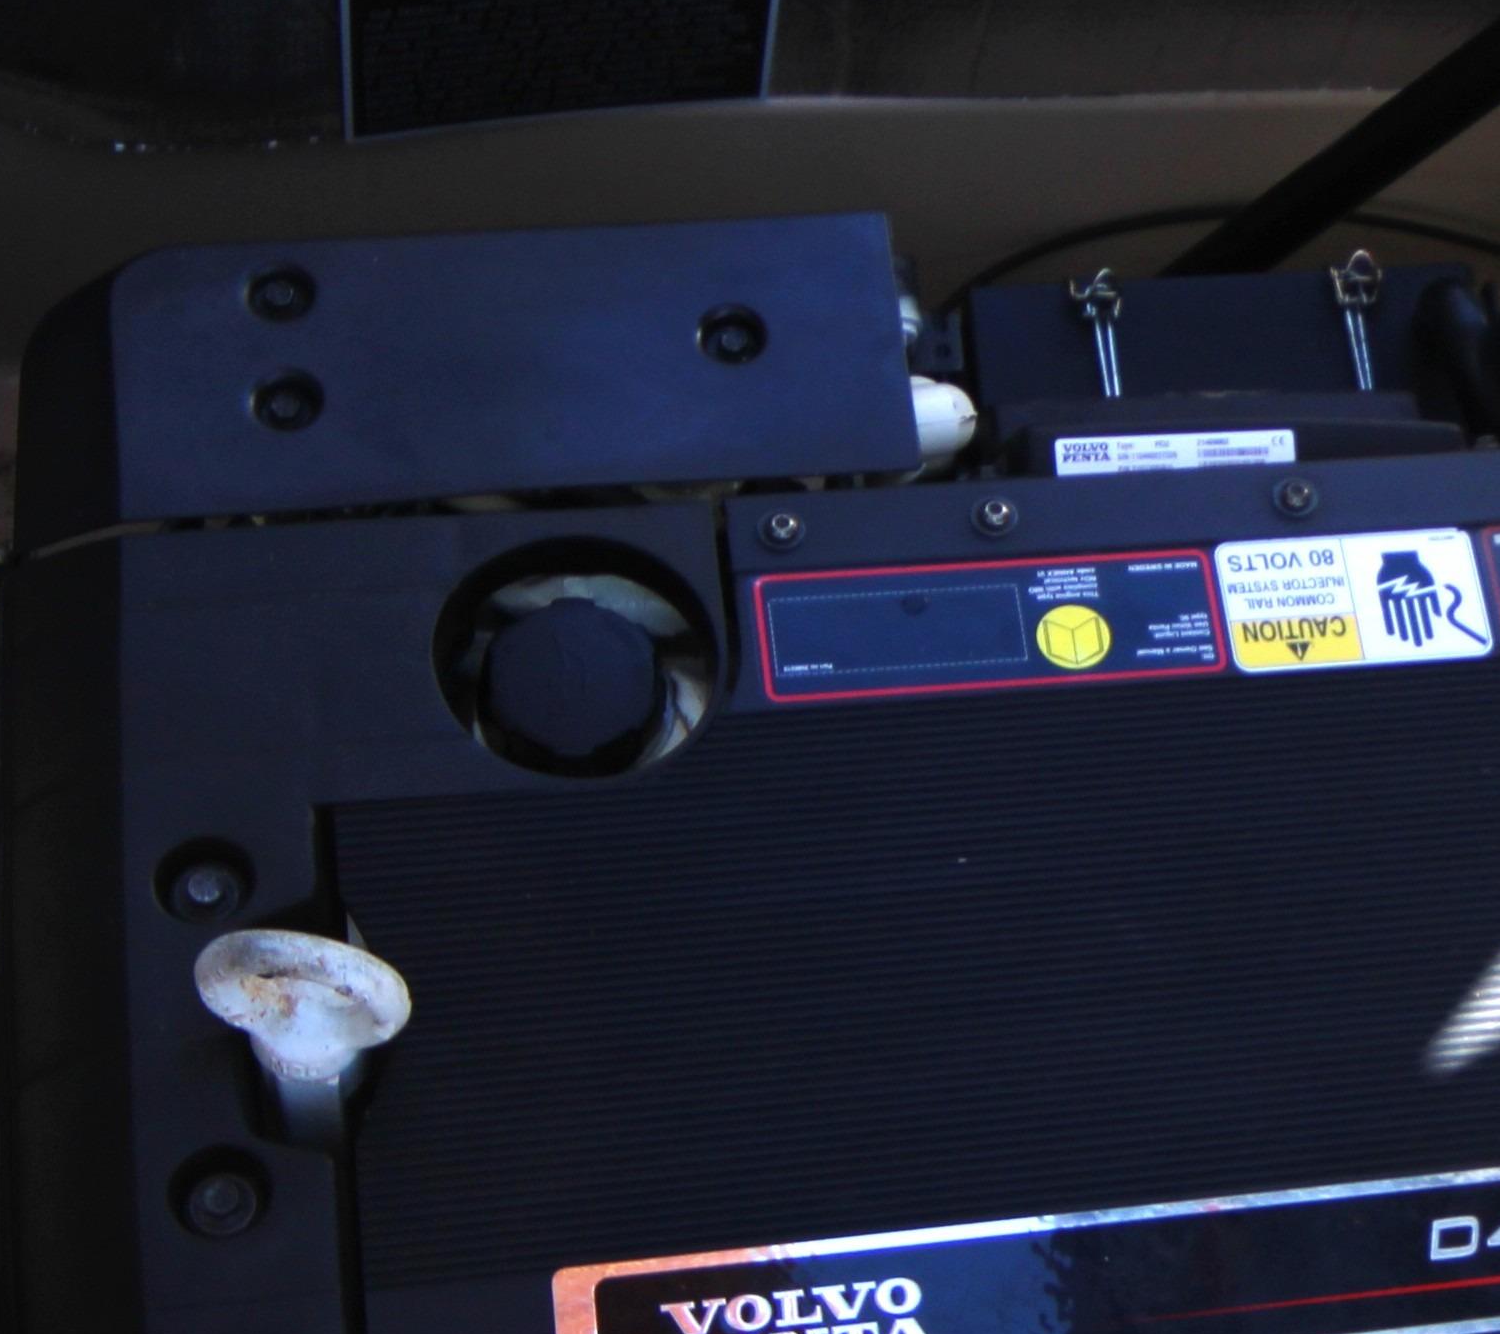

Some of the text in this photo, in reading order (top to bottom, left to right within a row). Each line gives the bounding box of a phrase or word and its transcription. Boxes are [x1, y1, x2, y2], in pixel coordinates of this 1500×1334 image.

[1063, 442, 1109, 452] VOLVO
[1062, 452, 1110, 463] PENTA
[1127, 562, 1163, 572] SWEDEN
[1174, 560, 1197, 569] MADE
[1227, 549, 1335, 572] 80 VOLTS
[1226, 576, 1345, 594] INJECTOR SYSTEM
[1244, 593, 1335, 609] COMMON RAIL
[1241, 616, 1347, 643] CAUTION
